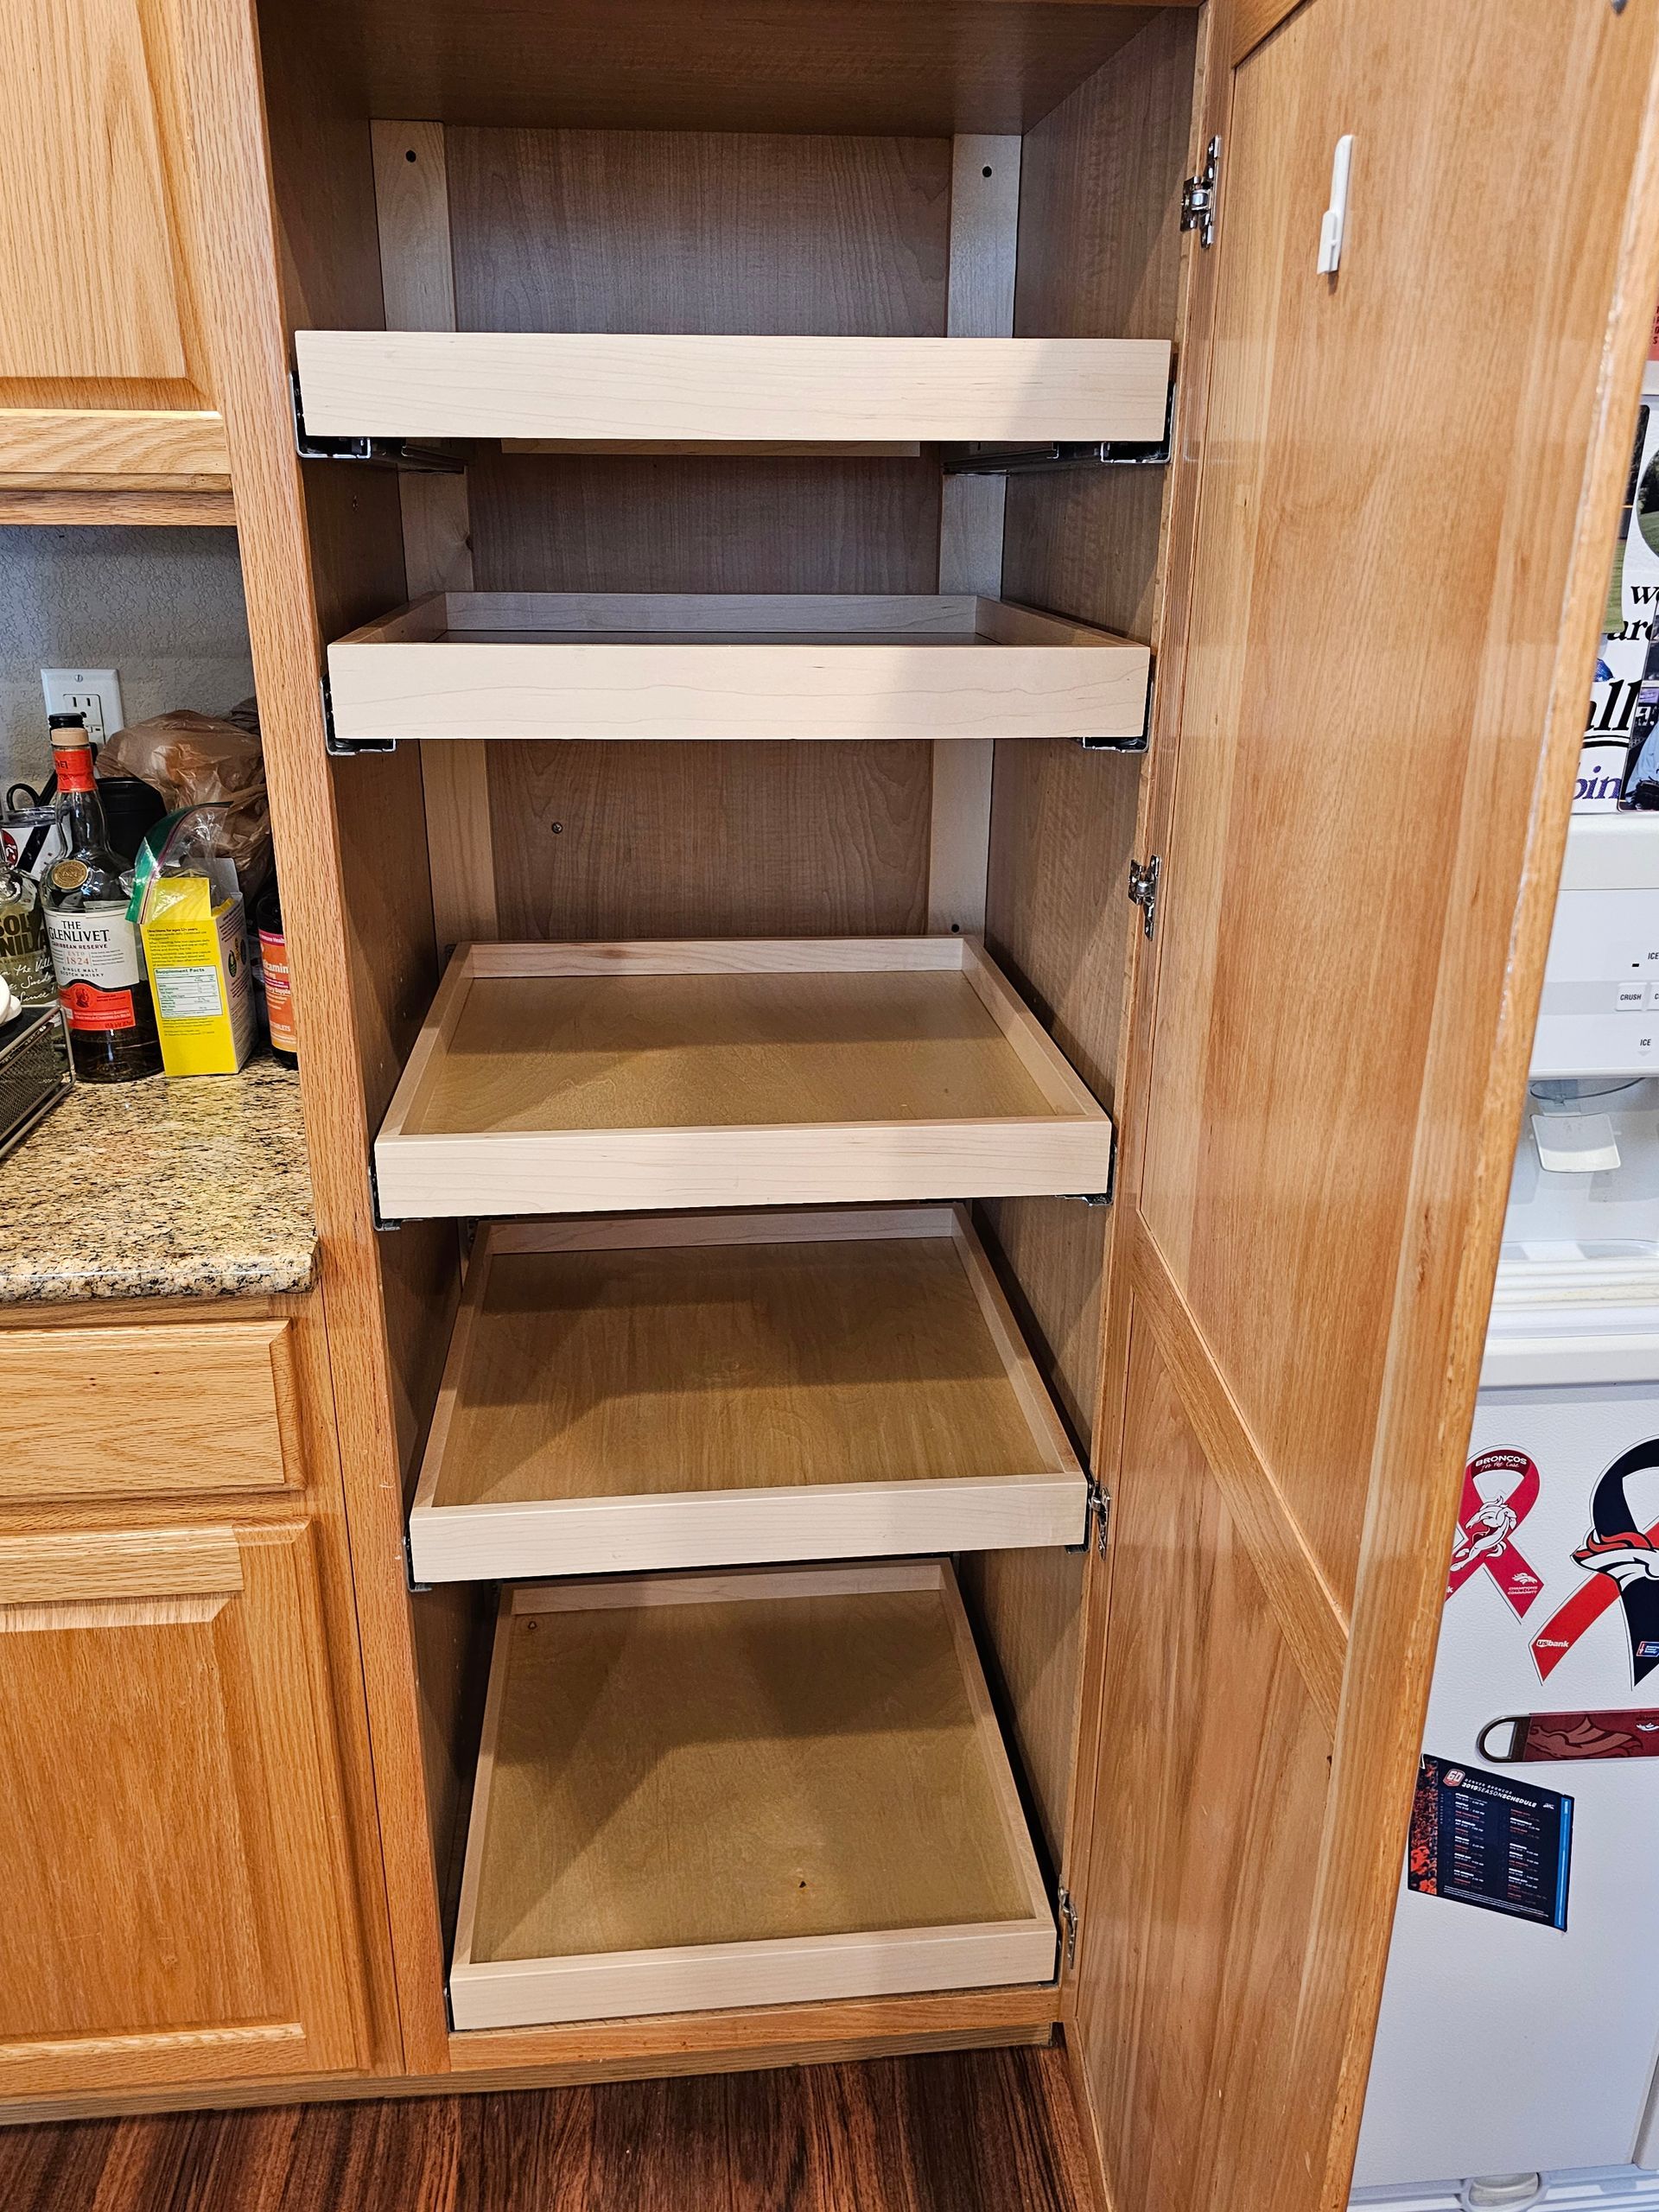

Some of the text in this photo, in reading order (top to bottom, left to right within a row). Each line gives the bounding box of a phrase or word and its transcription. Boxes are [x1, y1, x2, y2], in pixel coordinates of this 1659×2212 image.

[61, 920, 81, 930] THE
[67, 957, 89, 965] 1824
[1475, 1455, 1528, 1467] BRONCOS
